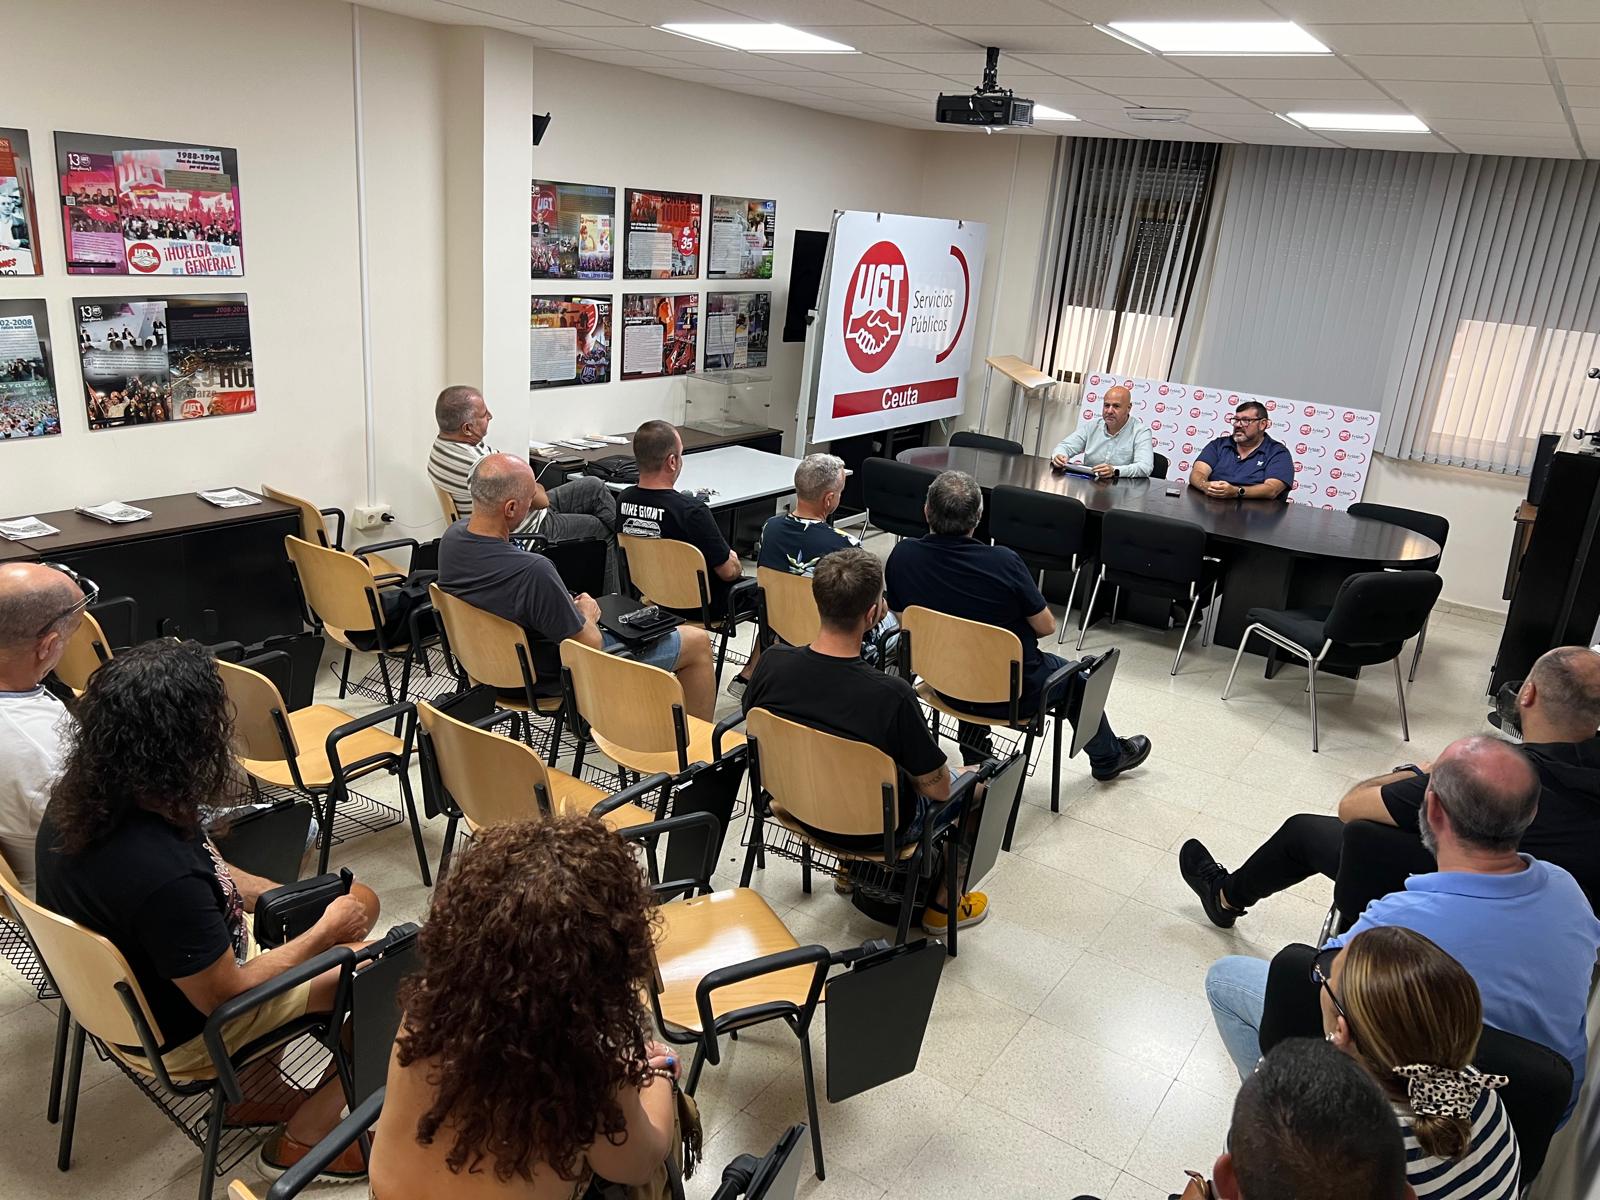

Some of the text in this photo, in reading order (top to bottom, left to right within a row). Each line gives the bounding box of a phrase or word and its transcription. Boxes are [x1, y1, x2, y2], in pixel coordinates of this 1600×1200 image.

[680, 237, 693, 250] 35
[185, 256, 236, 274] GENERAL!
[852, 264, 904, 313] UGT
[913, 290, 953, 309] Servicios
[910, 316, 948, 334] Públicos
[882, 386, 919, 410] Ceuta
